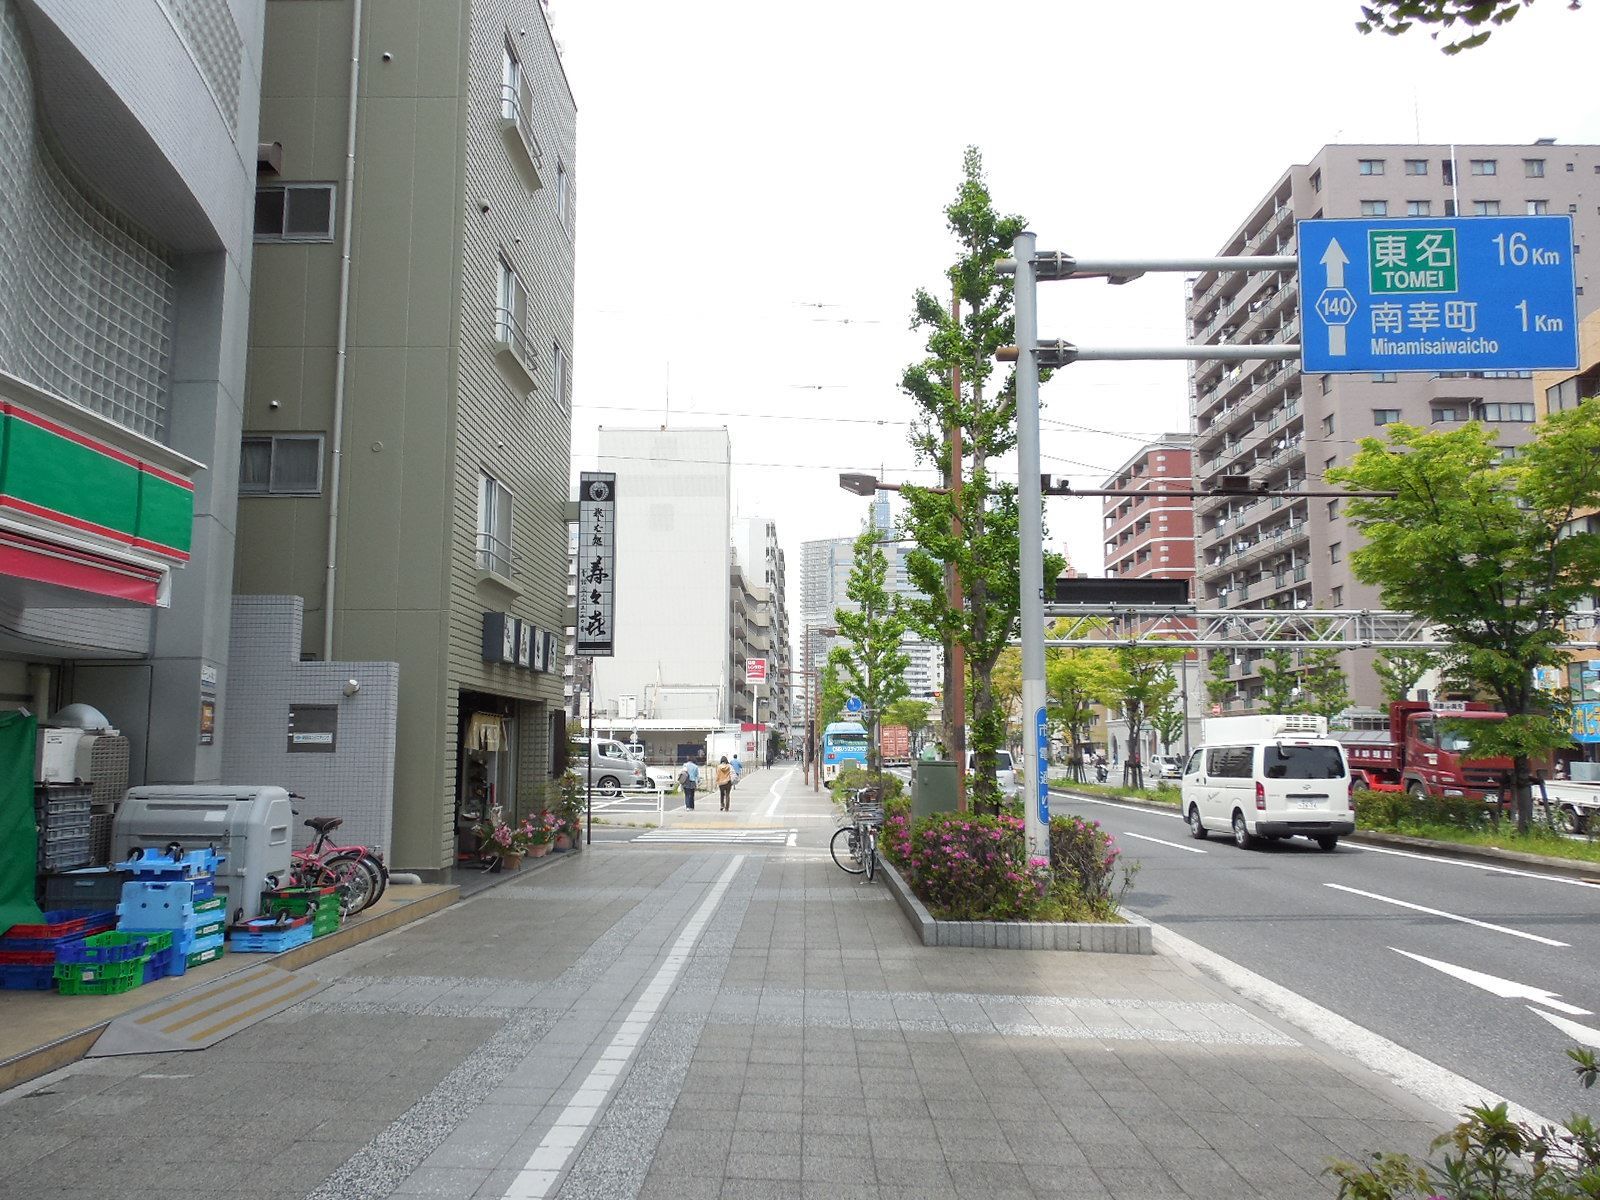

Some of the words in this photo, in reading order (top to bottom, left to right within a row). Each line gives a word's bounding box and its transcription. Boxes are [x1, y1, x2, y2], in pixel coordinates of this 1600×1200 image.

[1373, 234, 1451, 268] 東名
[1492, 232, 1529, 266] 16
[1532, 247, 1560, 266] Km
[1382, 270, 1444, 289] TOMEI
[1322, 297, 1351, 316] 140
[1369, 301, 1478, 334] 南幸町
[1515, 300, 1528, 332] 1
[1535, 315, 1563, 332] Km
[1371, 336, 1499, 356] Minamisaiwaicho
